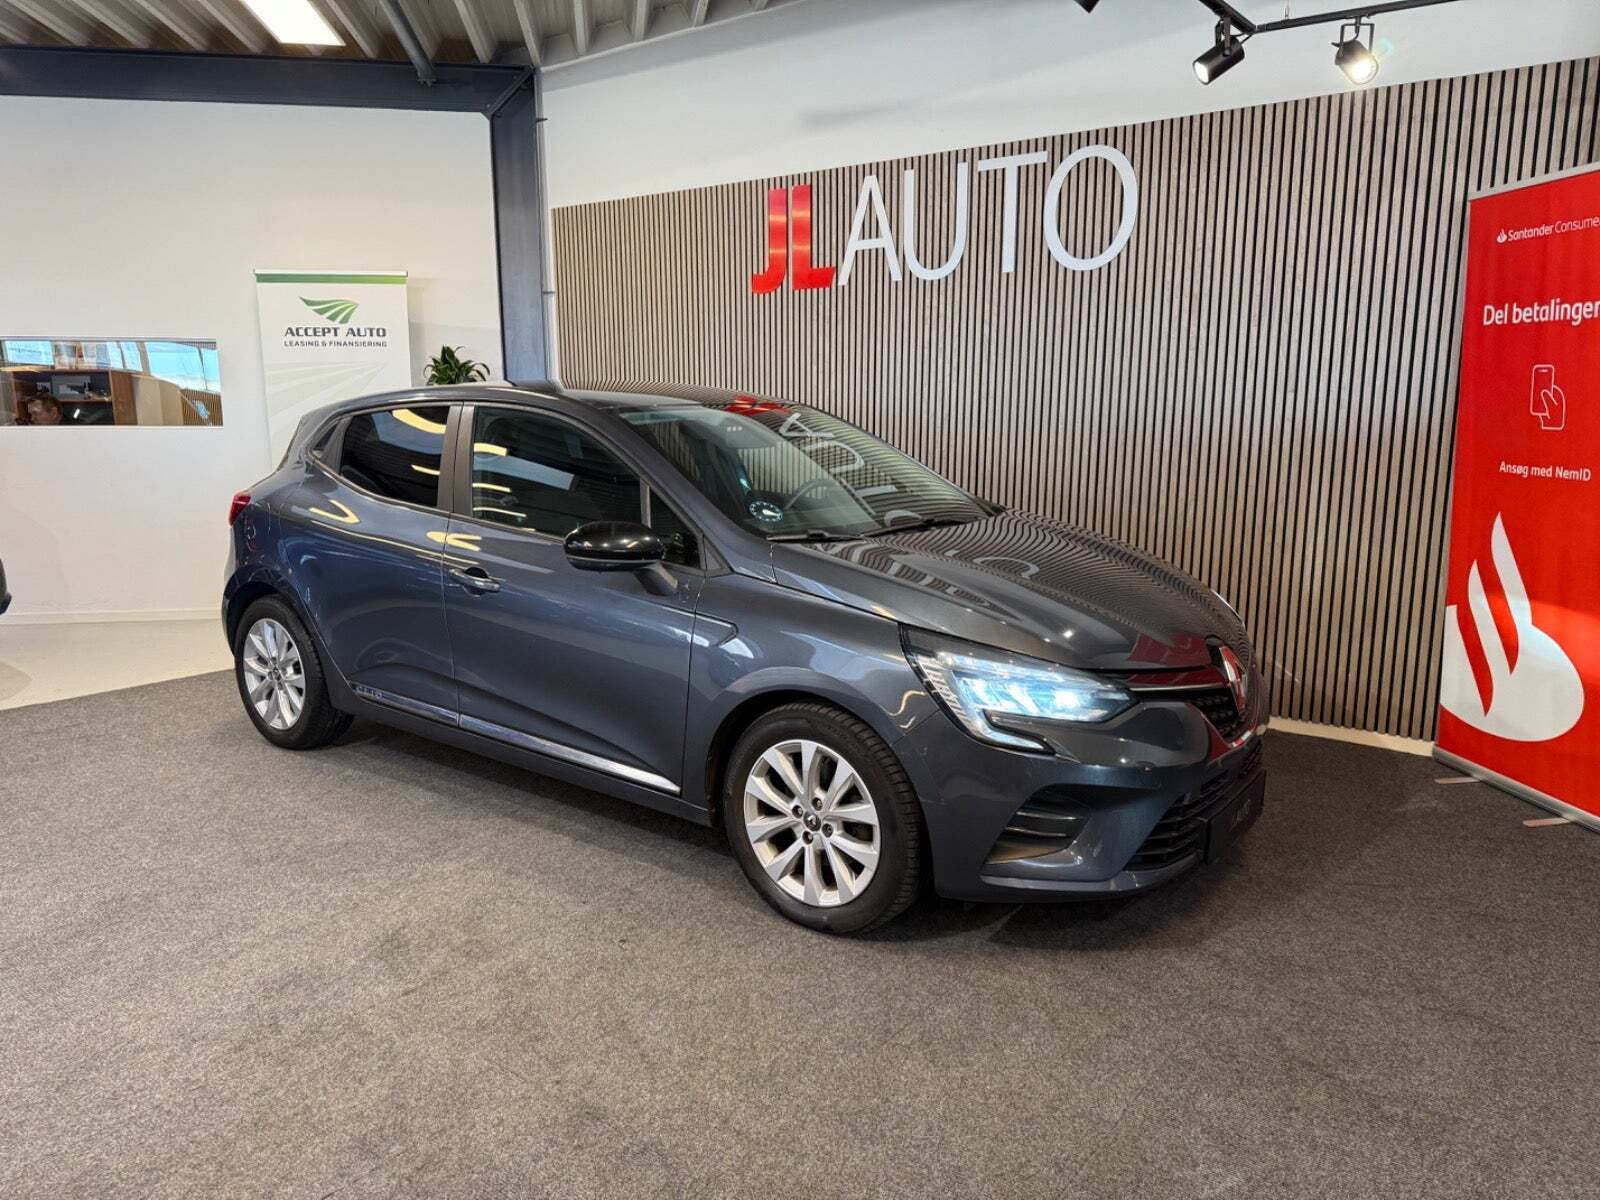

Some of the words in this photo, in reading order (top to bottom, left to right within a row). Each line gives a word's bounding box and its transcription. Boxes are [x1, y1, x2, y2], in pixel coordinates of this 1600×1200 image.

[1507, 224, 1554, 242] Santander
[1554, 216, 1600, 233] Consume
[1483, 303, 1509, 326] Del
[284, 326, 341, 338] ACCEPT
[345, 326, 387, 338] AUTO
[329, 340, 388, 348] FINANSIERING
[1499, 461, 1529, 478] Ansøg
[1531, 465, 1553, 477] med
[1555, 466, 1592, 481] NemID
